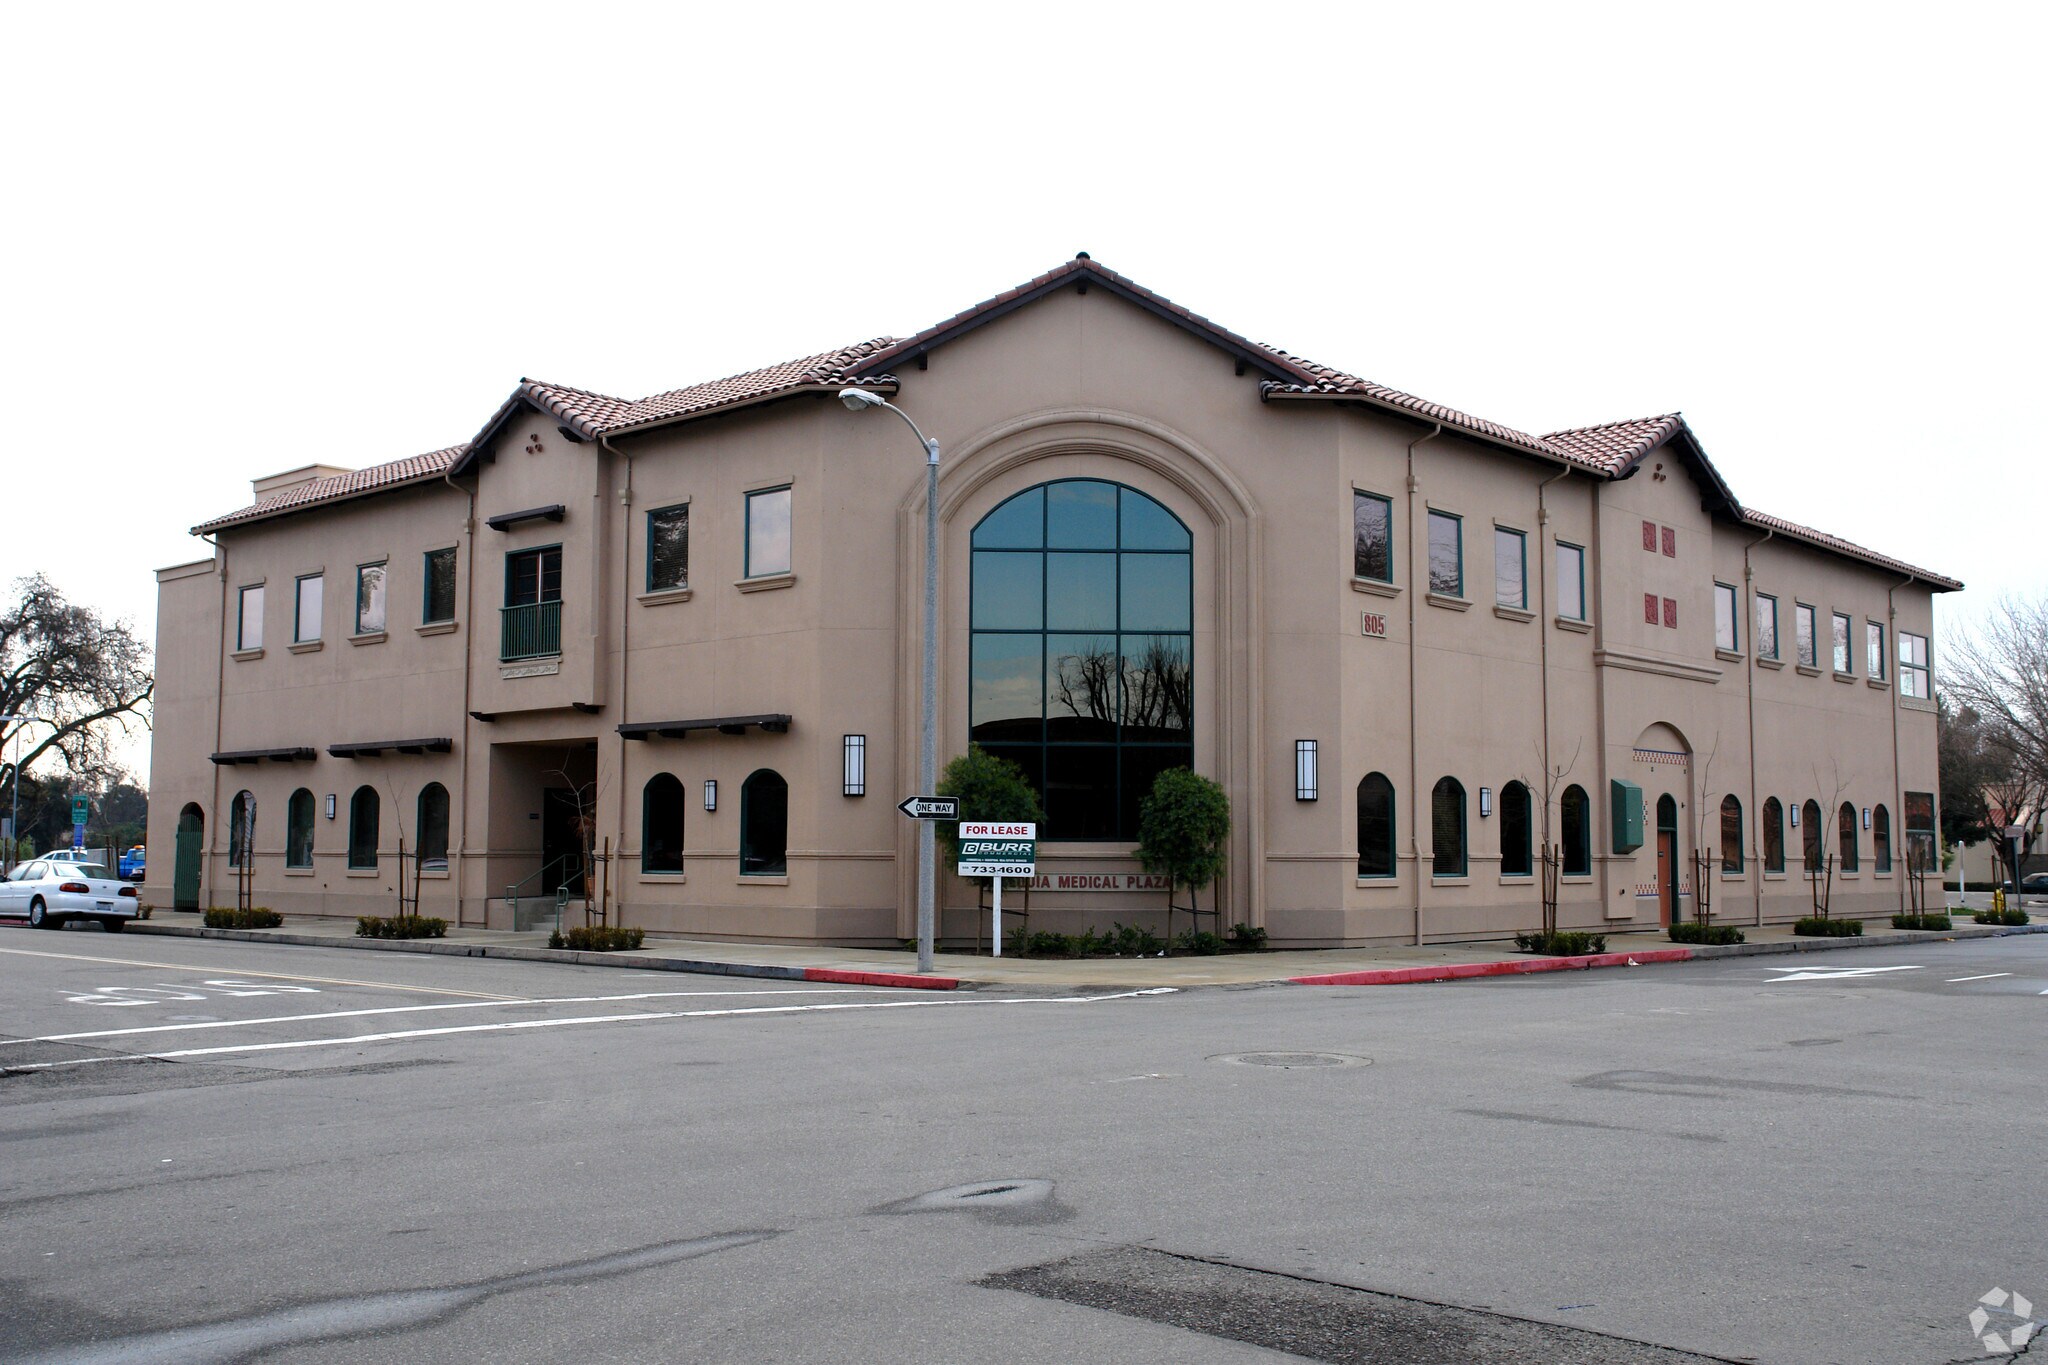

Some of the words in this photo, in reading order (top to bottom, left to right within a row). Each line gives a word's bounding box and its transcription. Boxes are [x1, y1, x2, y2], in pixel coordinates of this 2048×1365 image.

[1364, 614, 1385, 635] 805
[915, 803, 932, 812] ONE
[934, 804, 952, 812] WAY
[966, 825, 988, 835] FOR
[991, 826, 1028, 835] LEASE
[979, 842, 1033, 852] BURR
[971, 866, 1032, 874] 733-1600
[1058, 875, 1120, 889] MEDICAL
[1126, 875, 1171, 889] PLAZA
[57, 980, 321, 1007] STOP
